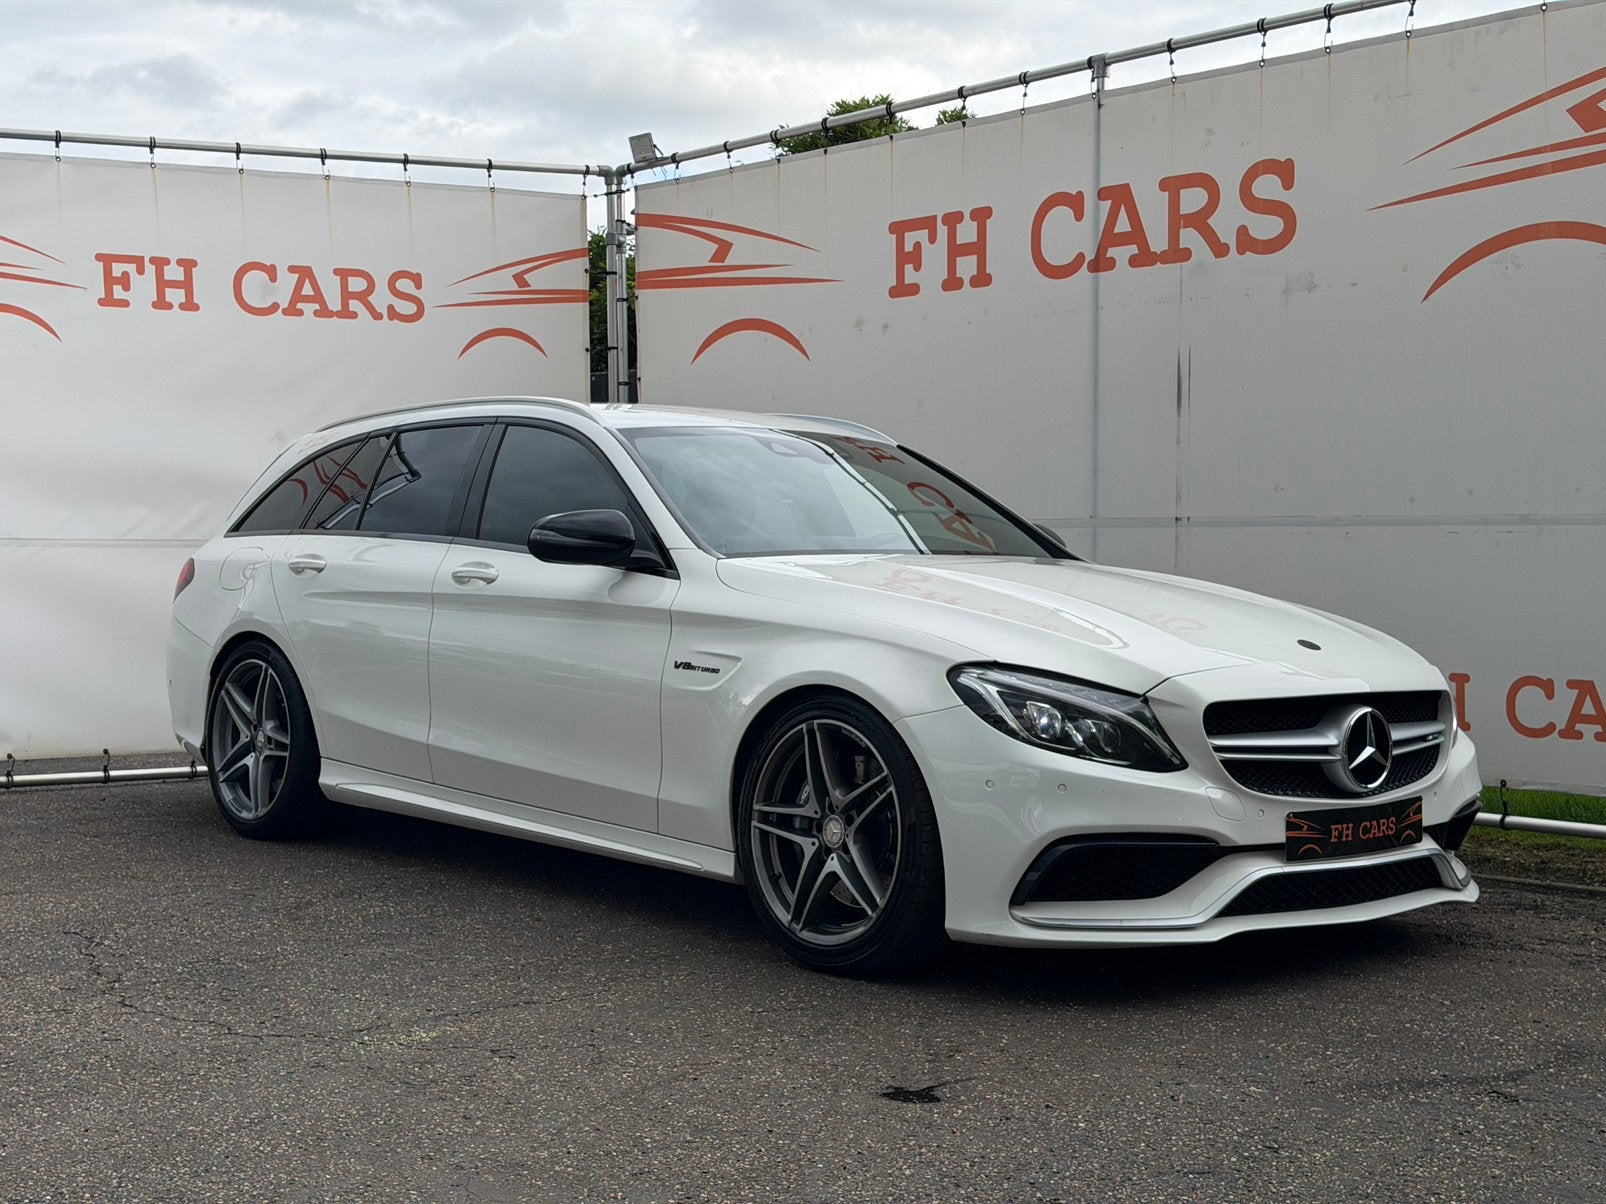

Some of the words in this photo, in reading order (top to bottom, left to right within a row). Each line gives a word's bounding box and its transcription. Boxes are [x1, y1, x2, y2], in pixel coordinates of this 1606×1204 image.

[889, 206, 993, 300] FH
[1031, 158, 1298, 281] CARS
[95, 253, 201, 313] FH
[233, 261, 426, 324] CARS
[1330, 823, 1354, 843] FH
[1359, 817, 1397, 840] CARS
